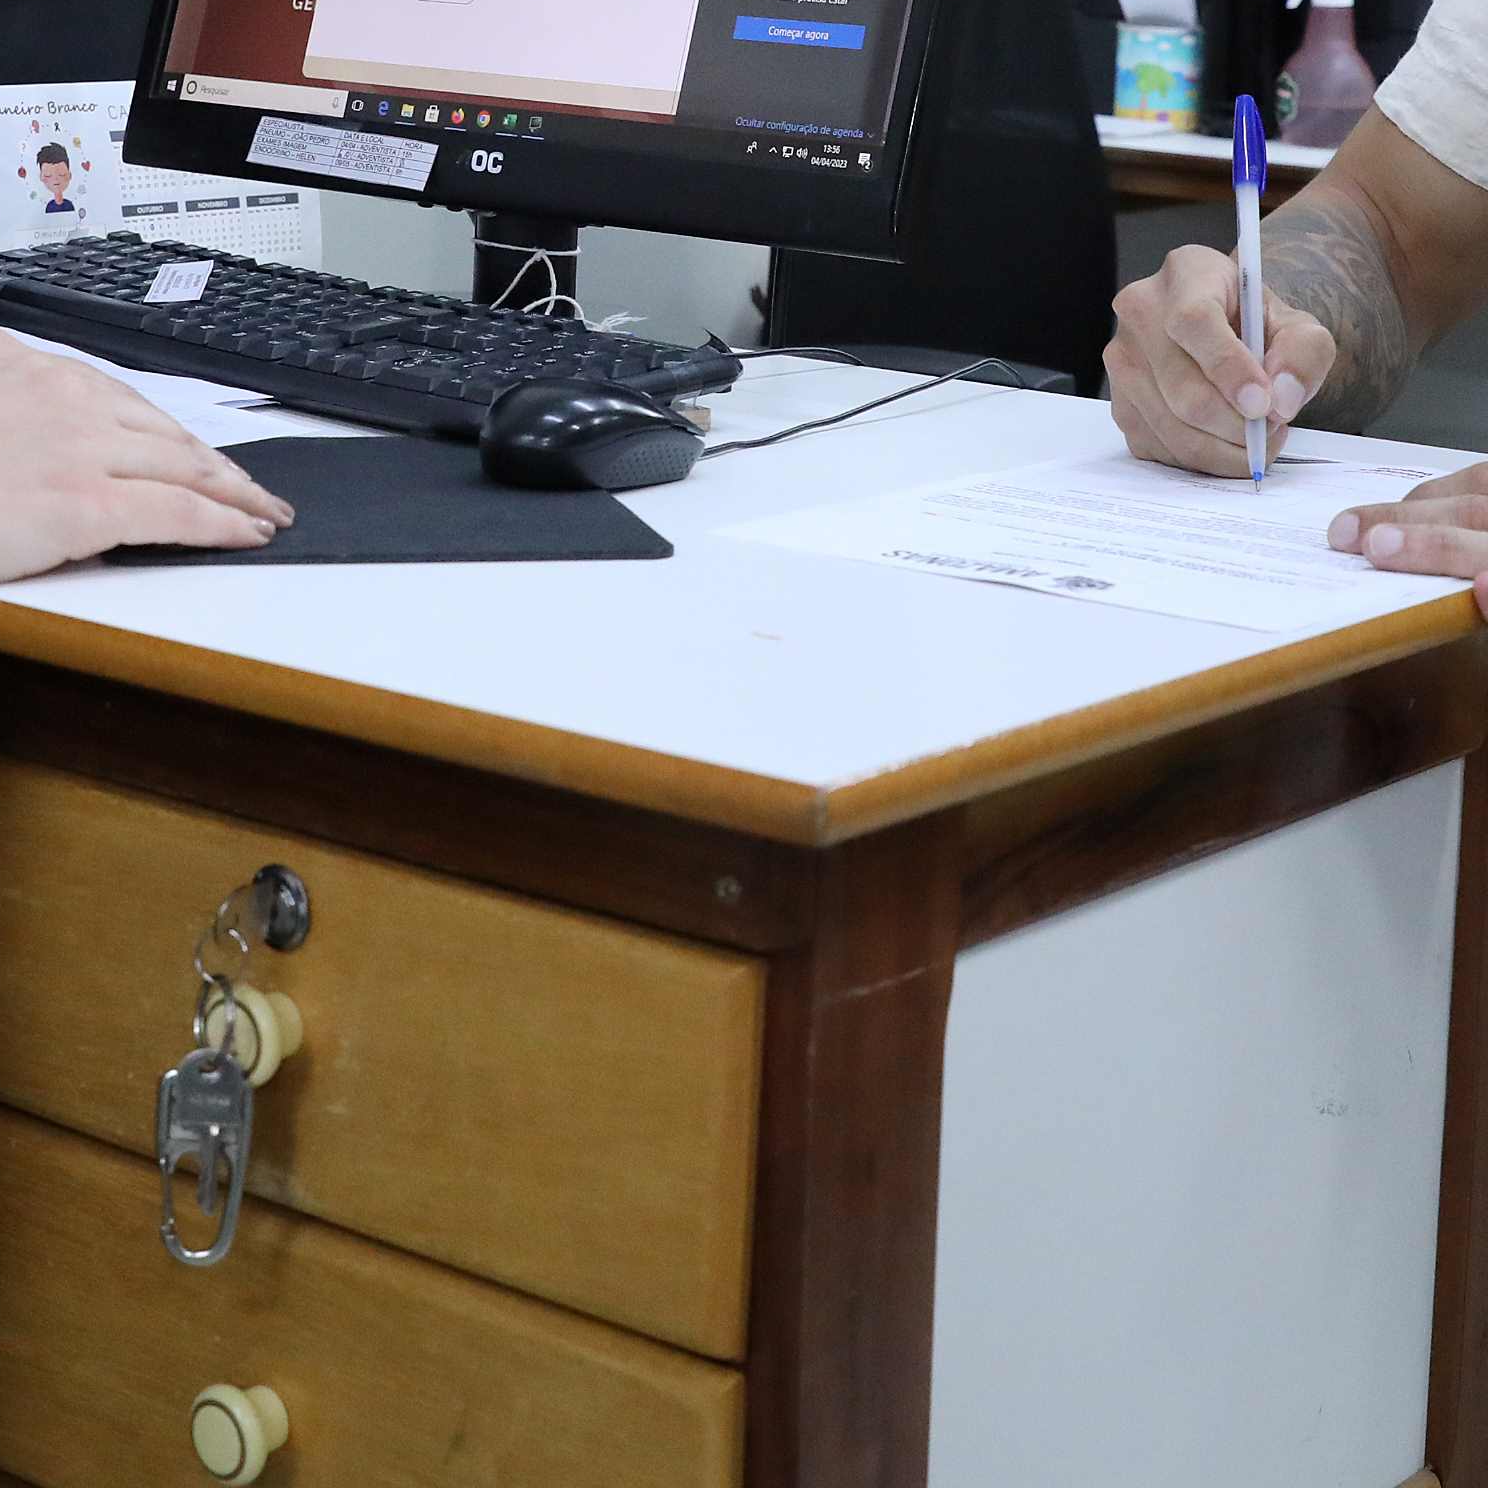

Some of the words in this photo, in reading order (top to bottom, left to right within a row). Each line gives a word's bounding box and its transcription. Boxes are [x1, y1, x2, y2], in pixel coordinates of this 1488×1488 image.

[767, 24, 805, 41] Começar
[804, 29, 829, 43] agora
[47, 101, 98, 115] Branco
[262, 118, 305, 131] ESPECIALISTA
[734, 115, 765, 129] Ocultar
[765, 118, 819, 136] configuração
[819, 124, 832, 136] de
[832, 125, 864, 140] agenda
[821, 143, 841, 155] 13:56
[809, 155, 848, 170] 04/04/2023
